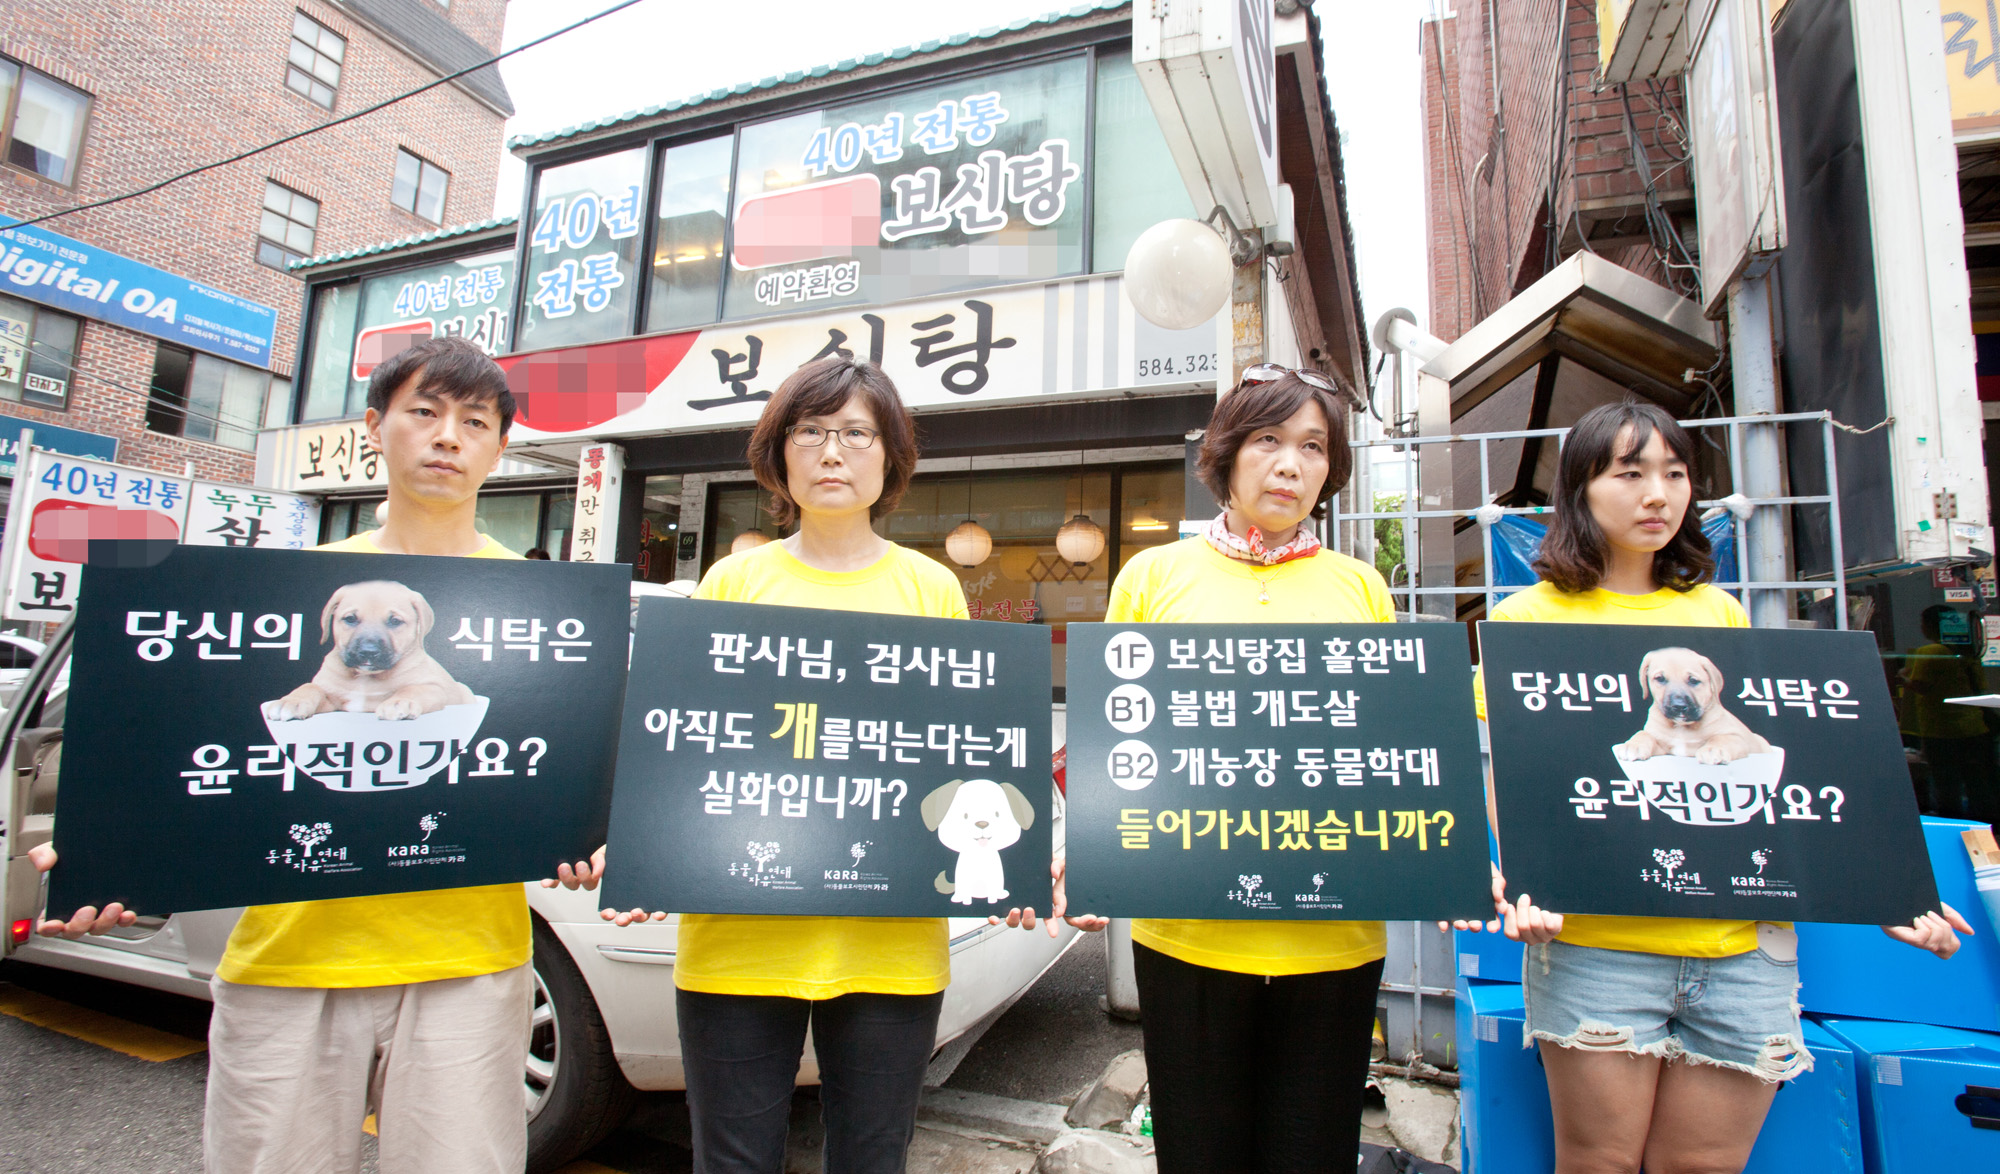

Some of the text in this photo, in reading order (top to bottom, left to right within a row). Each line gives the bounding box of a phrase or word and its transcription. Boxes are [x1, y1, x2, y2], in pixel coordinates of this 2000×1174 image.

[803, 92, 1009, 174] 40년 전통
[882, 140, 1080, 240] 보신탕
[16, 232, 58, 254] 정보기기
[531, 185, 640, 254] 40년
[0, 243, 178, 324] igital OA
[393, 266, 505, 317] 40년 전통
[534, 252, 624, 318] 전통
[755, 261, 860, 305] 예약환영
[29, 376, 63, 393] 타자기
[41, 462, 182, 509] 40년 전통
[207, 489, 277, 516] 녹두
[683, 536, 694, 545] 69
[20, 571, 76, 612] 보
[125, 610, 593, 663] 당신의 식탁은
[1110, 638, 1426, 675] 1F 보신탕집 홀완비
[708, 632, 996, 689] 판사님, 검사님!
[1110, 690, 1360, 728] B1 불법 개도살
[1511, 671, 1859, 719] 당신의 식탁은
[644, 702, 1027, 768] 아직도 개를먹는다는게
[180, 736, 549, 797] 윤리적인가요?
[1111, 747, 1440, 787] B2 개농장 동물학대
[699, 770, 908, 820] 실화입니까?
[1568, 777, 1845, 824] 윤리적인가요?
[1116, 808, 1455, 851] 들어가시겠습니까?
